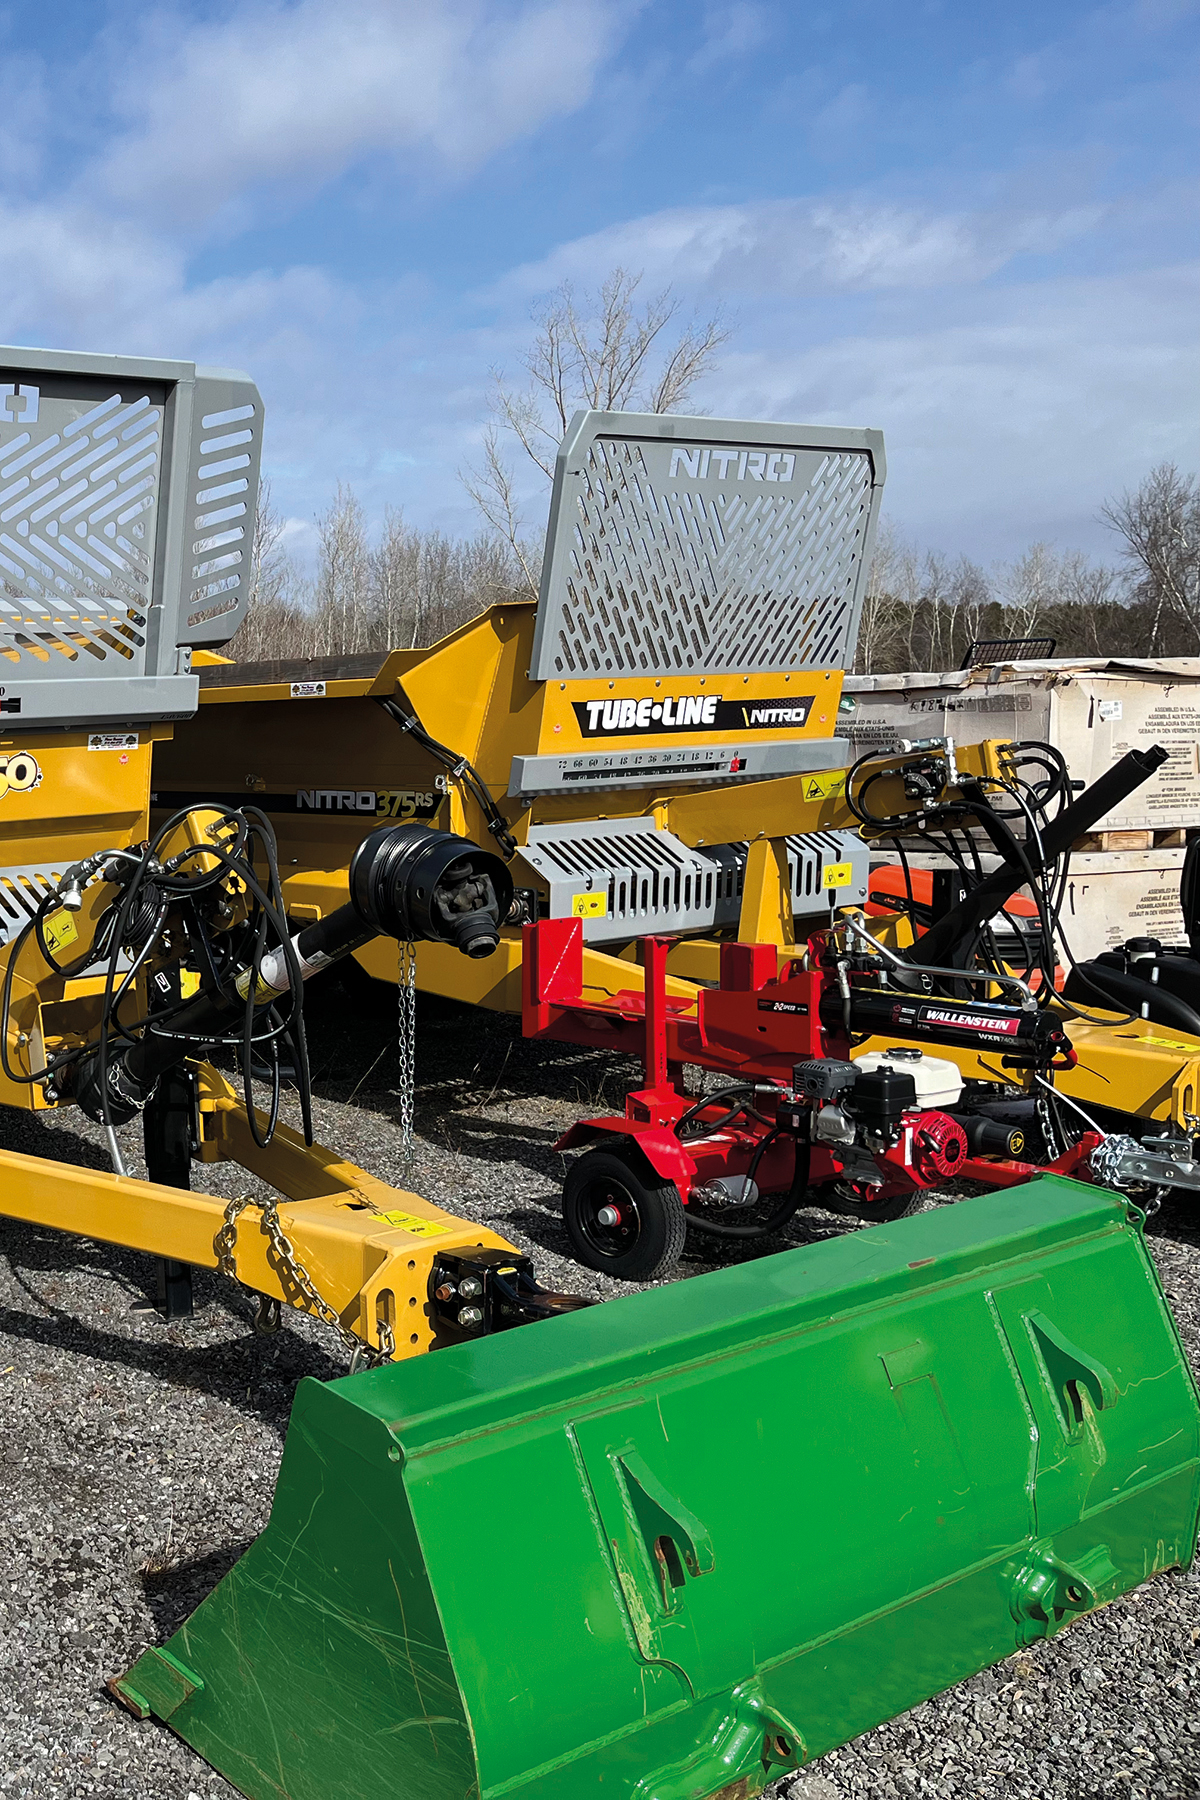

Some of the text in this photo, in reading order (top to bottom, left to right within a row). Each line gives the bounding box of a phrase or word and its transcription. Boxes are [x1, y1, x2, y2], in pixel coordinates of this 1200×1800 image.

[669, 448, 796, 482] NITRO
[750, 707, 805, 724] NITRO
[573, 759, 583, 768] 66
[588, 758, 598, 767] 60
[648, 755, 657, 764] 36
[662, 754, 671, 762] 30
[691, 752, 700, 760] 18
[926, 1009, 1011, 1031] WALLENSTEIN
